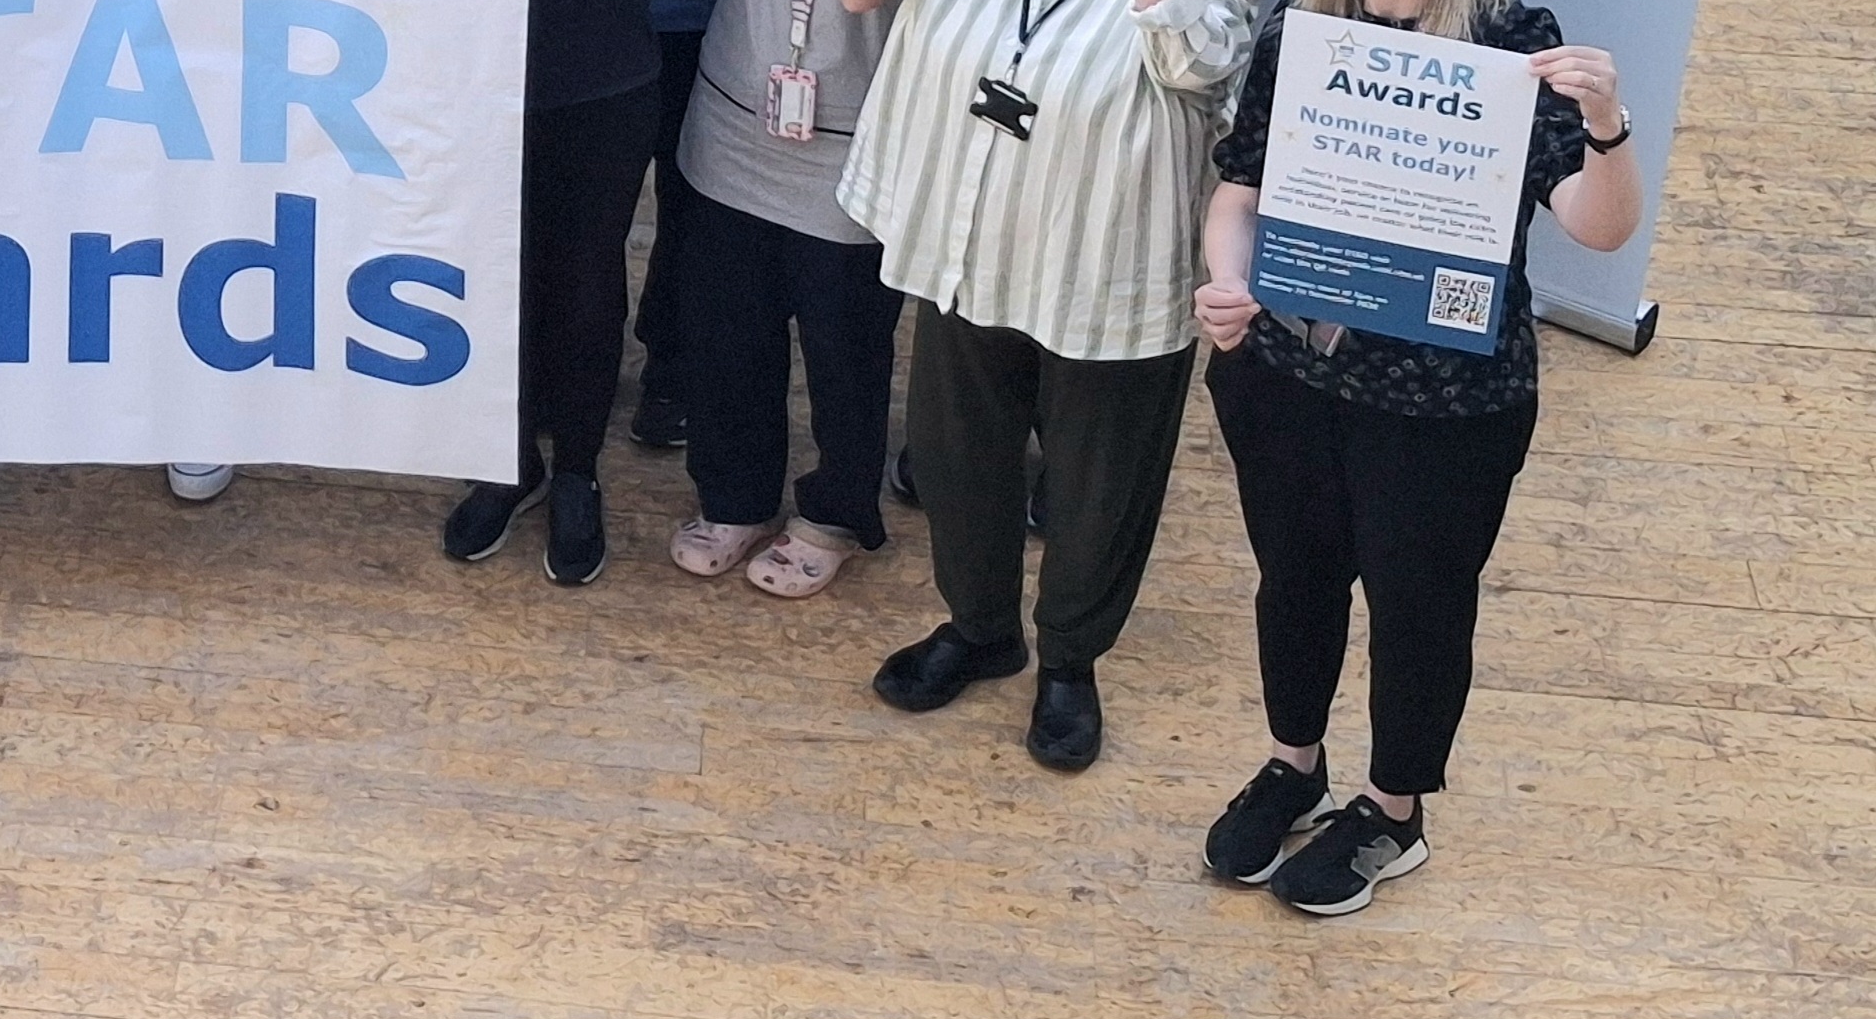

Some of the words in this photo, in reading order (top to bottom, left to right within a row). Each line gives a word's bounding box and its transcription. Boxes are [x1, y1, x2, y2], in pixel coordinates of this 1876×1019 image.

[1366, 46, 1477, 91] STAR
[1326, 68, 1484, 121] Awards
[1300, 105, 1428, 147] Nominate
[1437, 137, 1500, 160] your
[1312, 134, 1382, 163] STAR
[1391, 151, 1476, 182] today!
